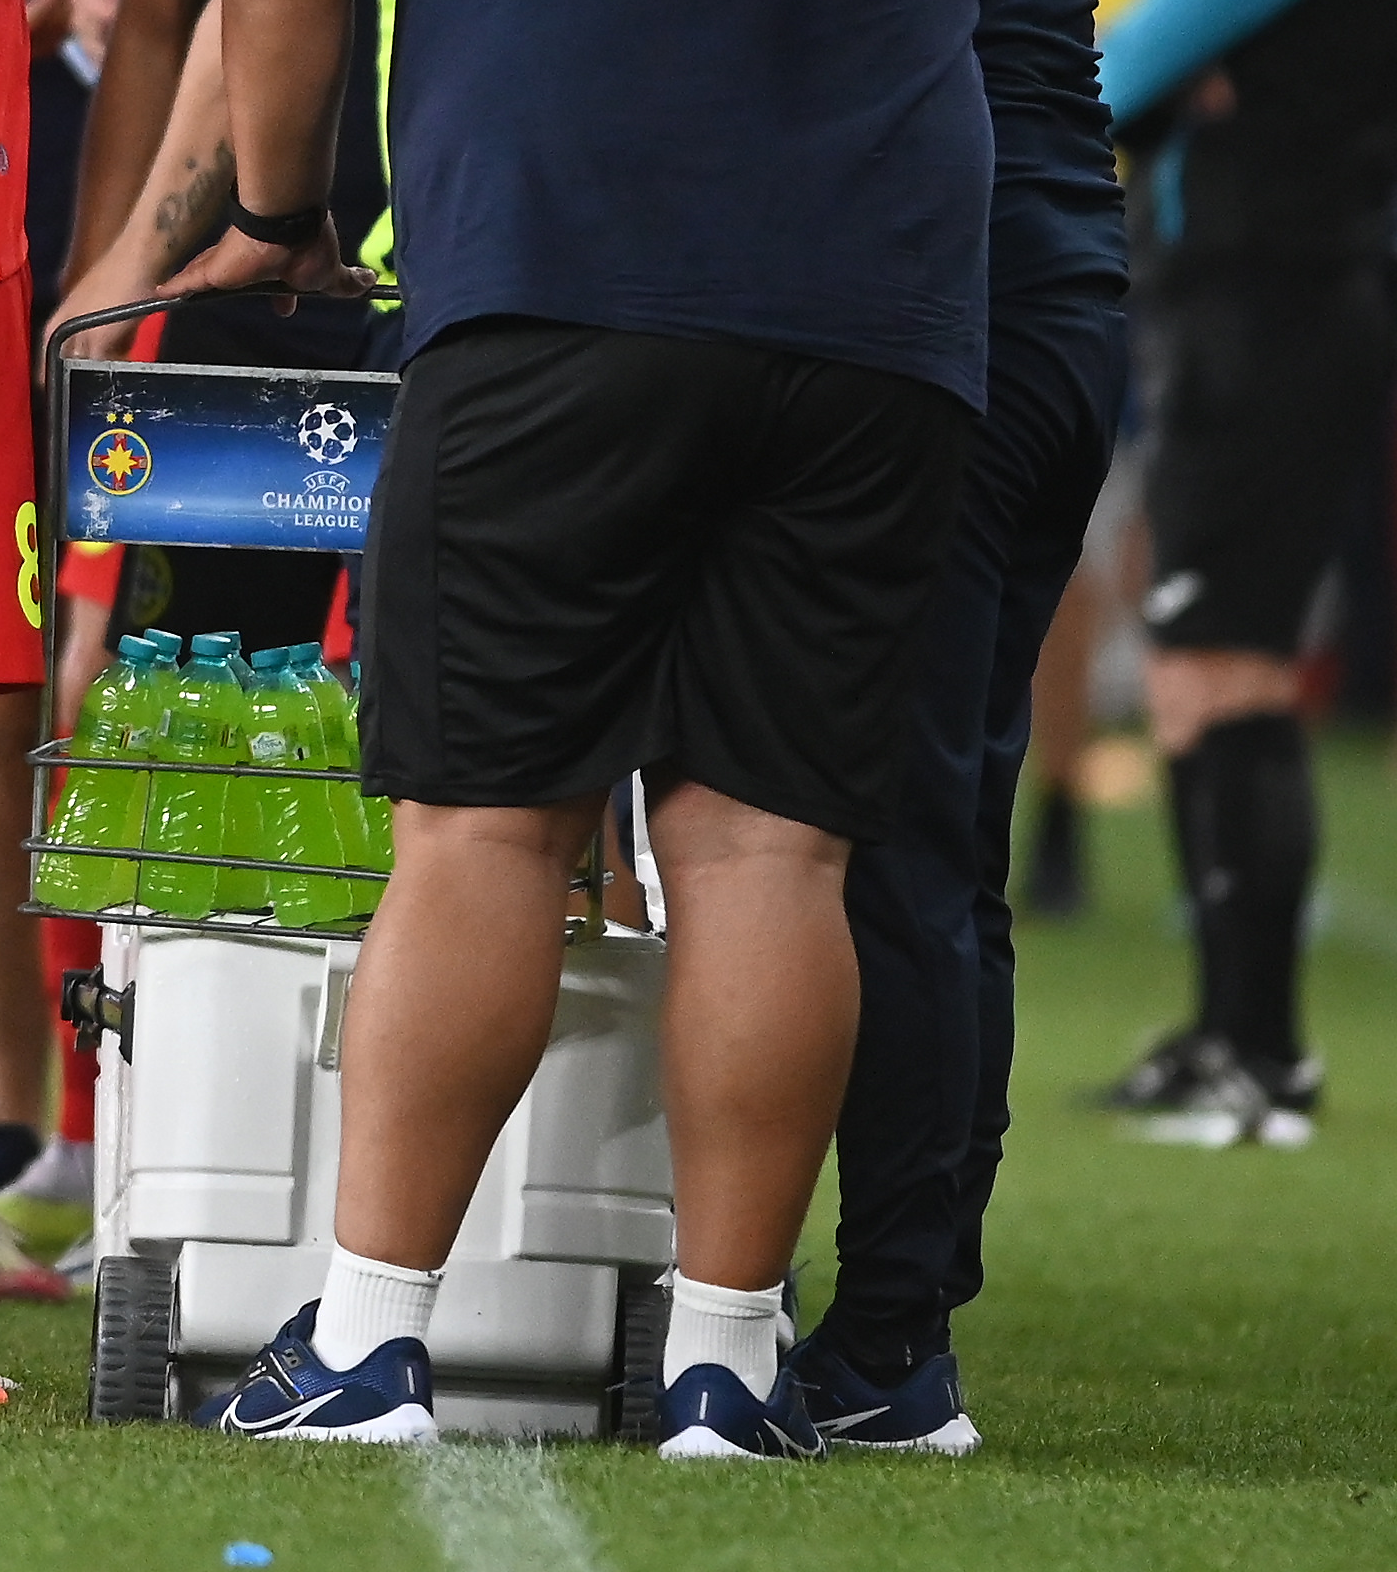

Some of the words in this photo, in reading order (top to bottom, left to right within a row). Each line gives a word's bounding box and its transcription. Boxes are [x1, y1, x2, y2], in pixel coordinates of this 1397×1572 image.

[305, 473, 347, 491] UEFA
[262, 491, 372, 513] CHAMPION
[294, 513, 361, 529] LEAGUE
